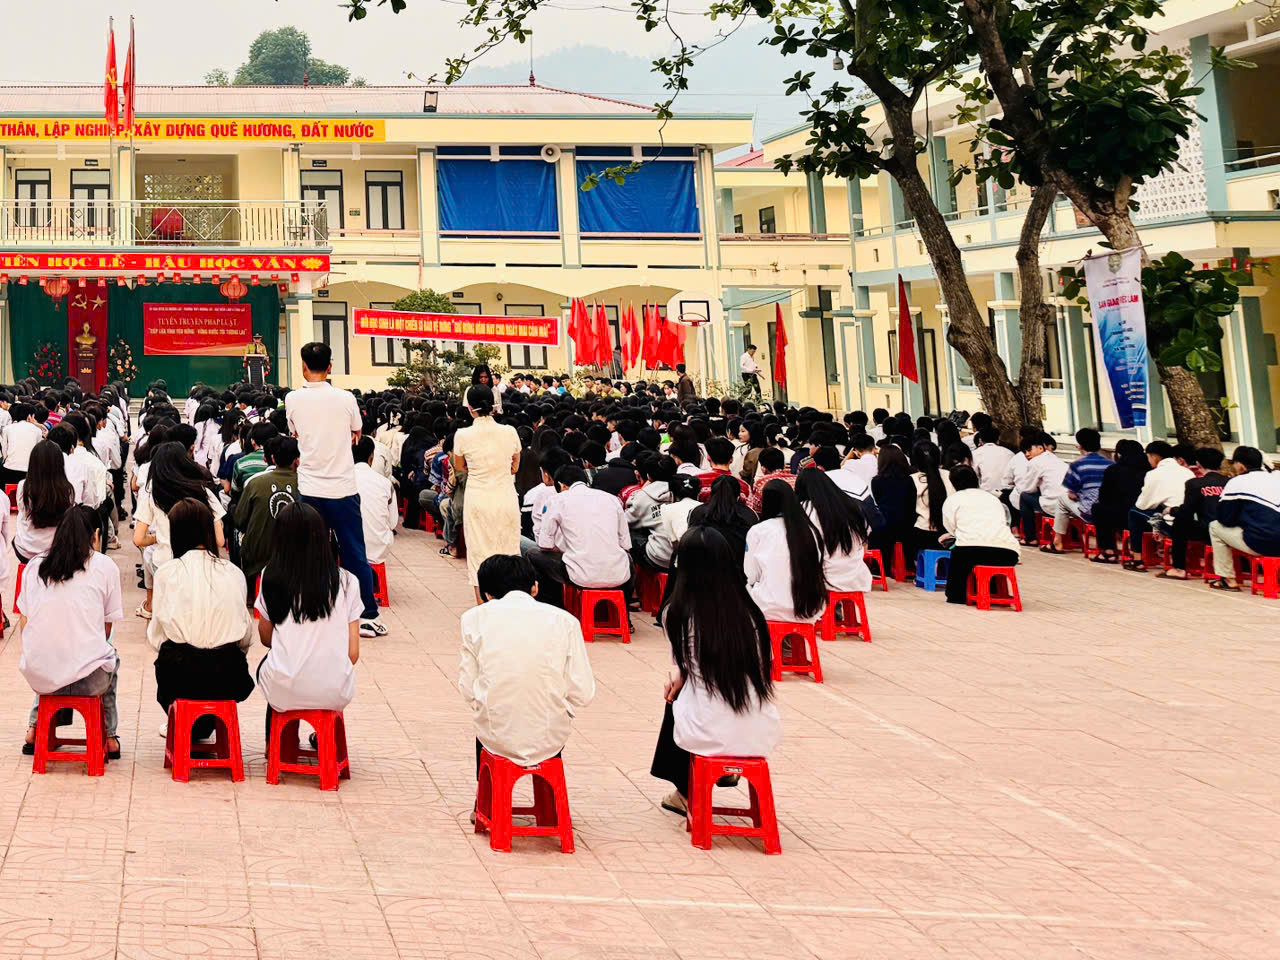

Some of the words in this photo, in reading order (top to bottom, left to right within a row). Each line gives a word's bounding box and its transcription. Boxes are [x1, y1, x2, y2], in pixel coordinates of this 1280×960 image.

[0, 122, 40, 138] THÂN,
[44, 123, 70, 138] LẬP
[134, 122, 160, 136] XÂY
[166, 123, 206, 139] DỰNG
[210, 122, 238, 138] QUÊ
[243, 123, 296, 138] HƯƠNG,
[301, 121, 328, 138] ĐẤT
[334, 123, 375, 138] NƯỚC
[47, 255, 92, 270] HỌC
[145, 256, 191, 270] HẬU
[199, 256, 246, 271] HỌC
[251, 256, 297, 269] VĂN
